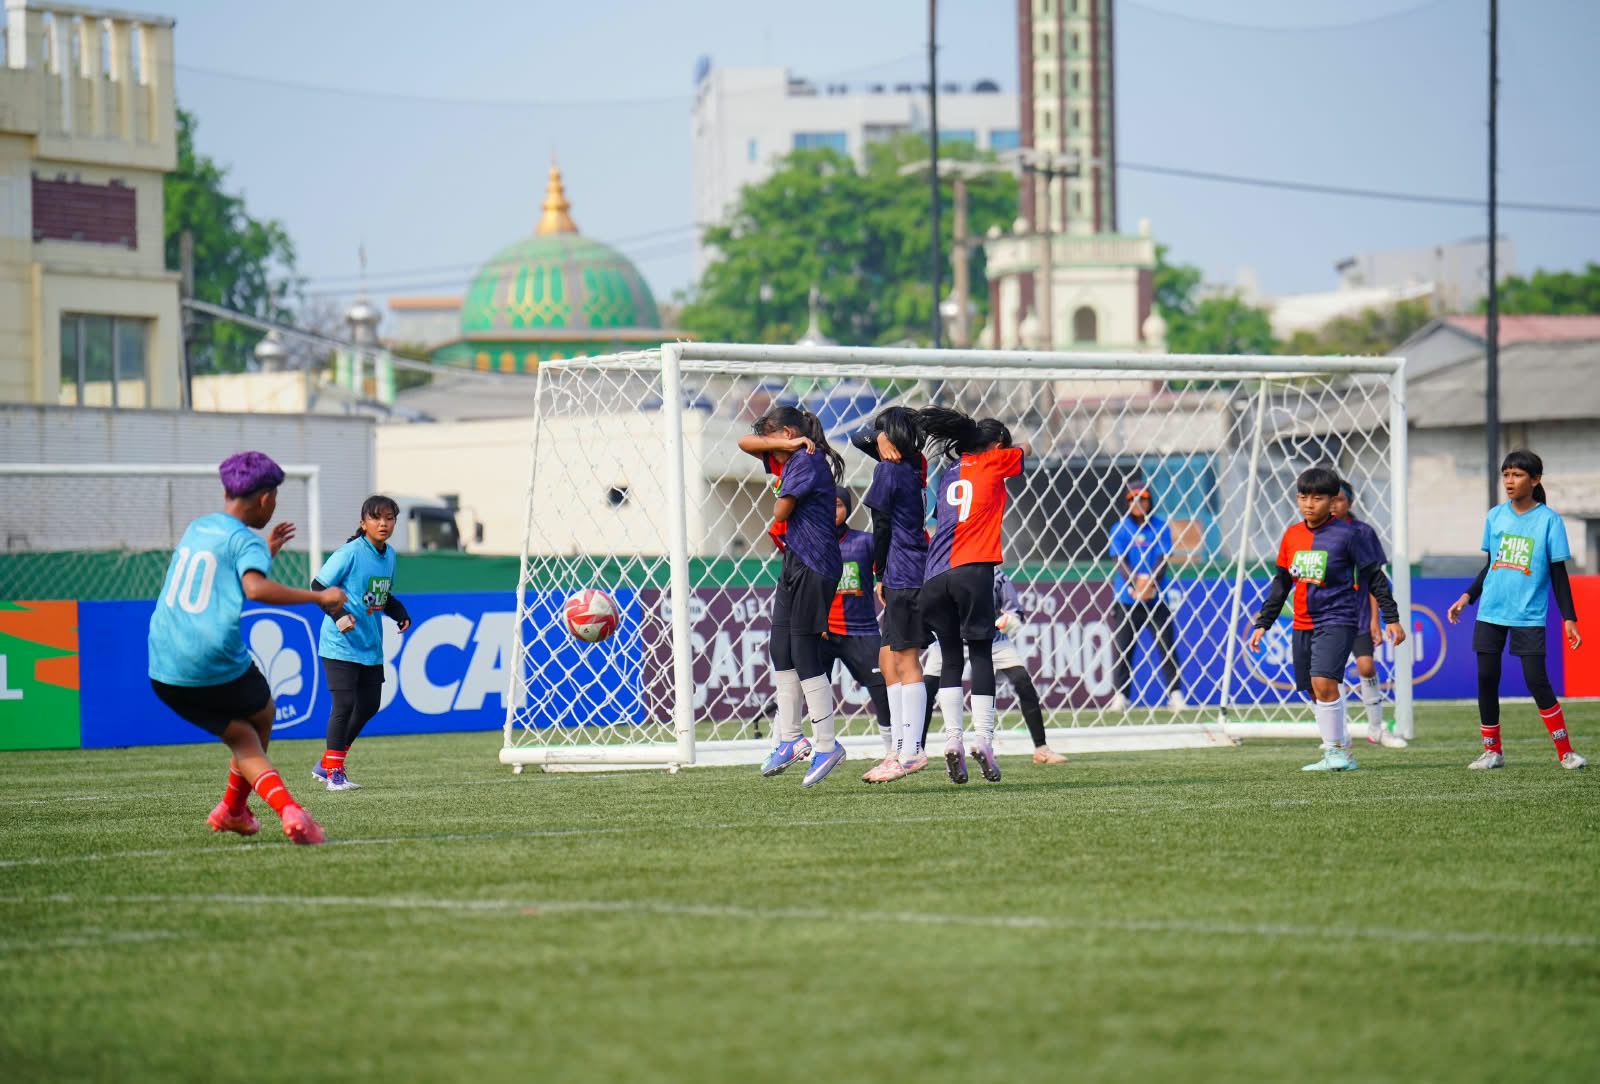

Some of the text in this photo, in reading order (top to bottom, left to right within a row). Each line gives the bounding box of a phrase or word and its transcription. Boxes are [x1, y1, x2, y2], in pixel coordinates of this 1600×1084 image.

[947, 480, 973, 523] 9
[1500, 536, 1529, 554] Milk
[1296, 553, 1324, 566] Milk
[1502, 550, 1529, 566] Life
[165, 546, 217, 614] 10
